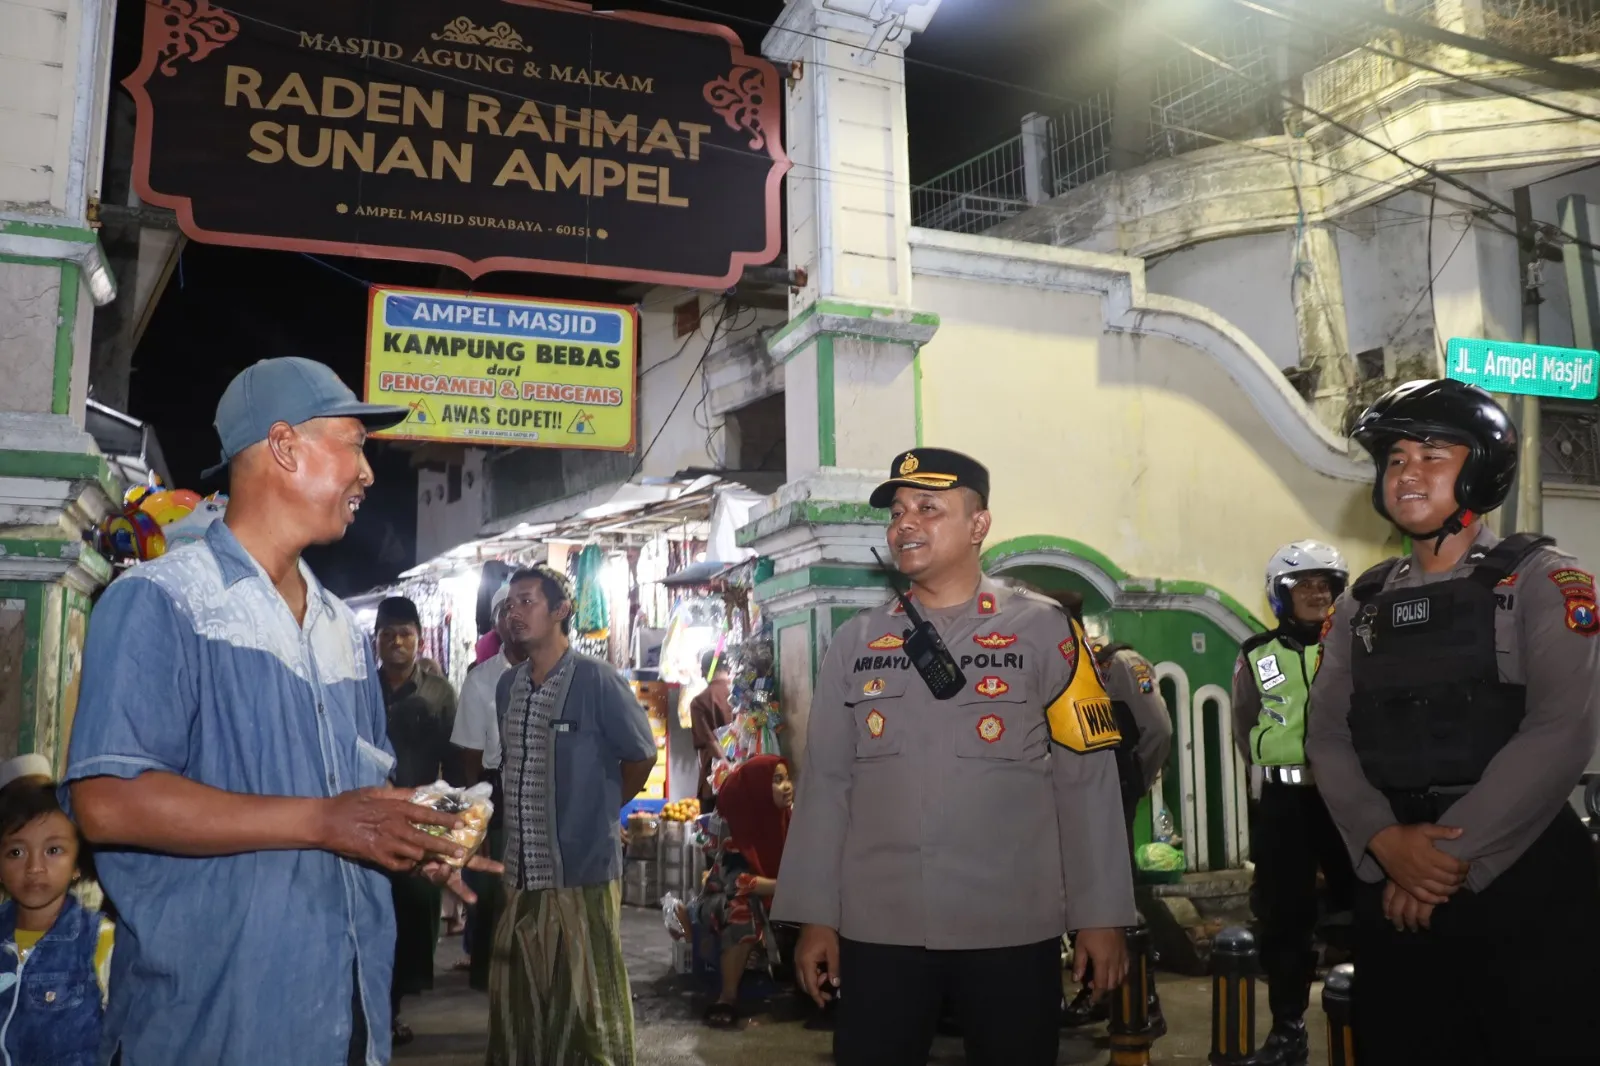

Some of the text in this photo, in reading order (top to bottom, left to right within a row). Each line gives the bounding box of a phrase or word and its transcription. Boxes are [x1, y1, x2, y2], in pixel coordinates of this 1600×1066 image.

[299, 31, 655, 94] MASJID AGUNG & MAKAM
[224, 64, 712, 161] RADEN RAHMAT
[246, 120, 690, 208] SUNAN AMPEL
[354, 204, 407, 220] AMPEL
[409, 209, 465, 226] MASJID
[467, 215, 543, 233] SURABAYA
[555, 224, 592, 238] 60151
[412, 302, 598, 337] AMPEL MASJID
[383, 331, 621, 369] KAMPUNG BEBAS
[486, 363, 522, 378] dari
[1484, 350, 1537, 385] Ampel
[1541, 356, 1593, 391] Masjid
[379, 371, 624, 406] PENGAMEN & PENGEMIS
[441, 403, 563, 430] AWAS COPET!!
[1395, 601, 1427, 623] POLISI
[960, 652, 1024, 670] POLRI
